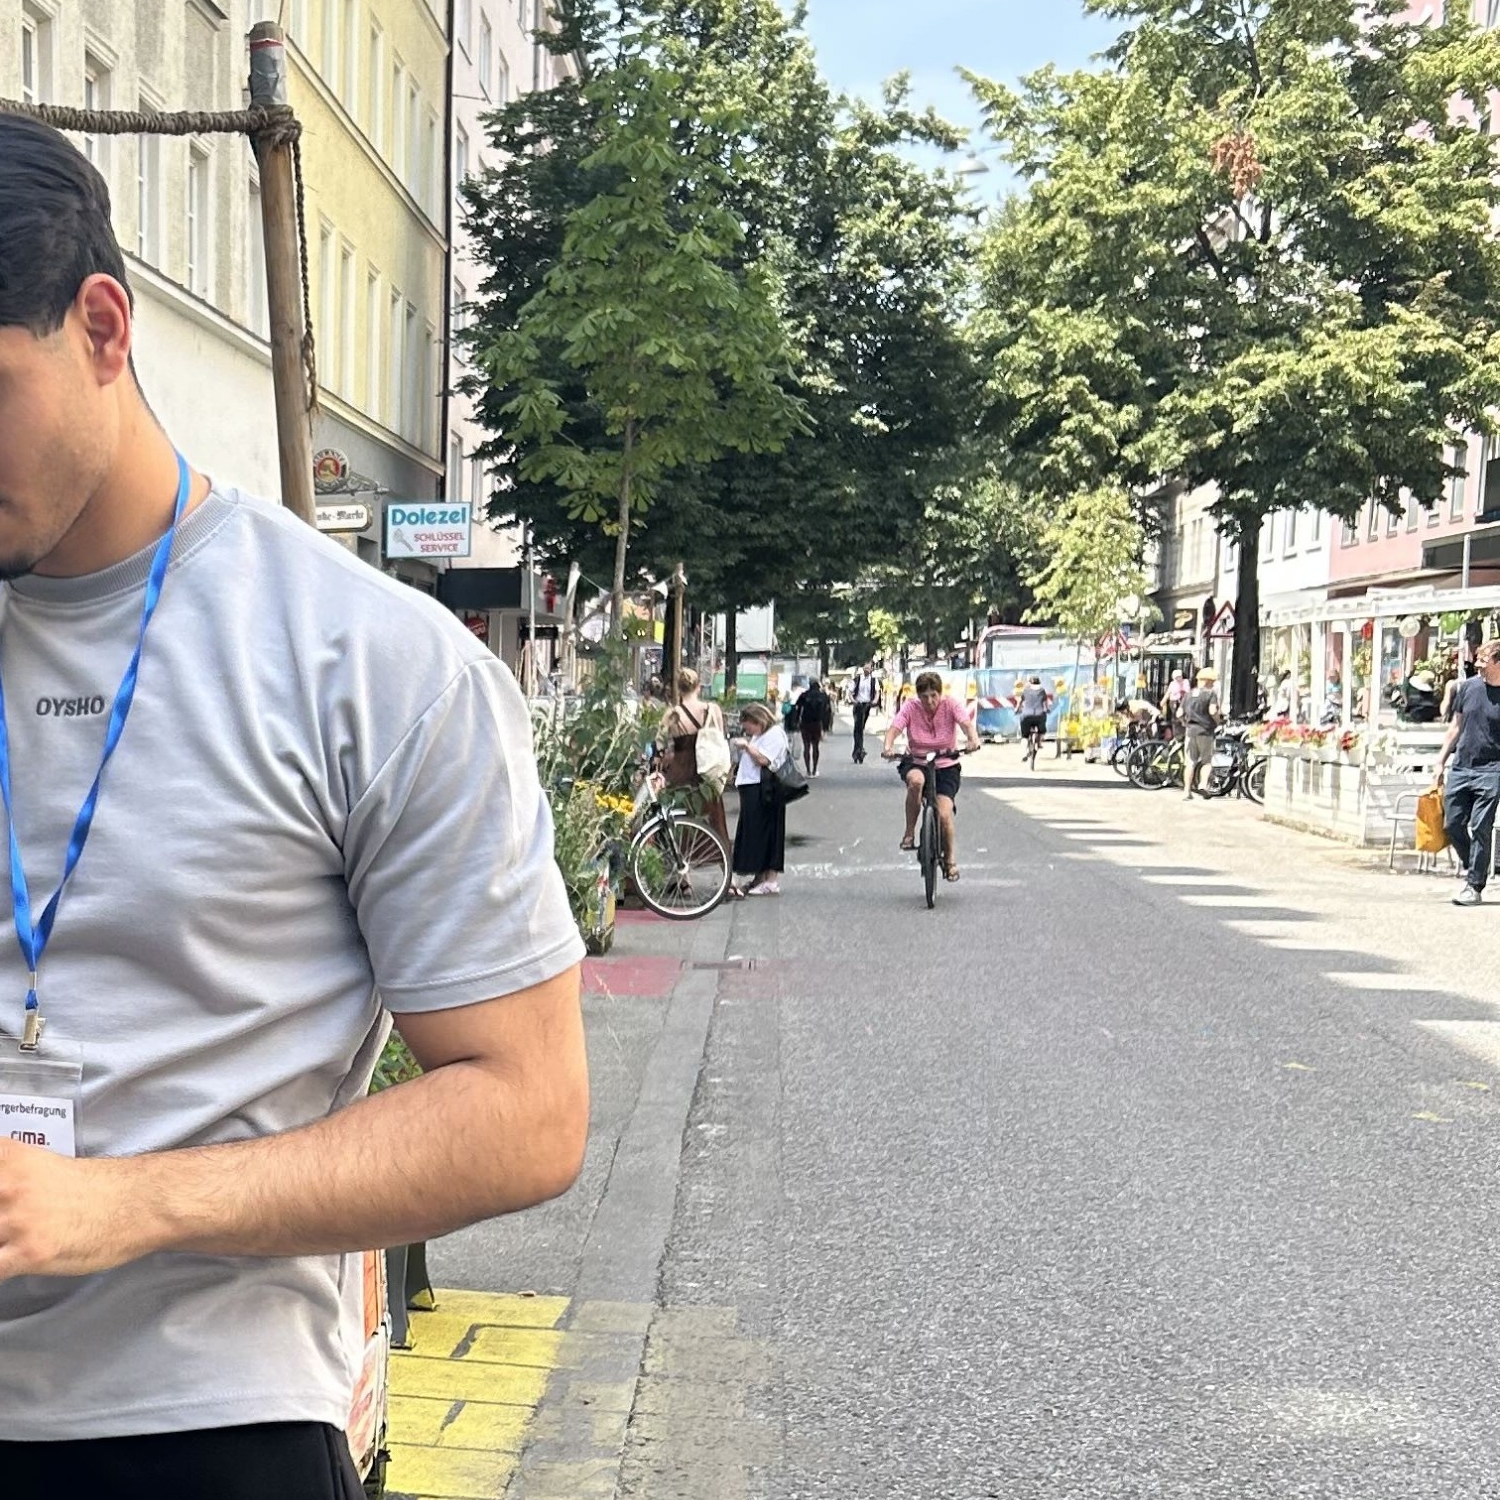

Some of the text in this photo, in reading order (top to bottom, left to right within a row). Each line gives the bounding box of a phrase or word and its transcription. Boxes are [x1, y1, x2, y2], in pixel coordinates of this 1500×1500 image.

[391, 507, 466, 525] Dolezel
[414, 531, 465, 542] SCHLÜSSEL
[420, 544, 458, 552] SERVICE
[36, 695, 105, 717] OYSHO
